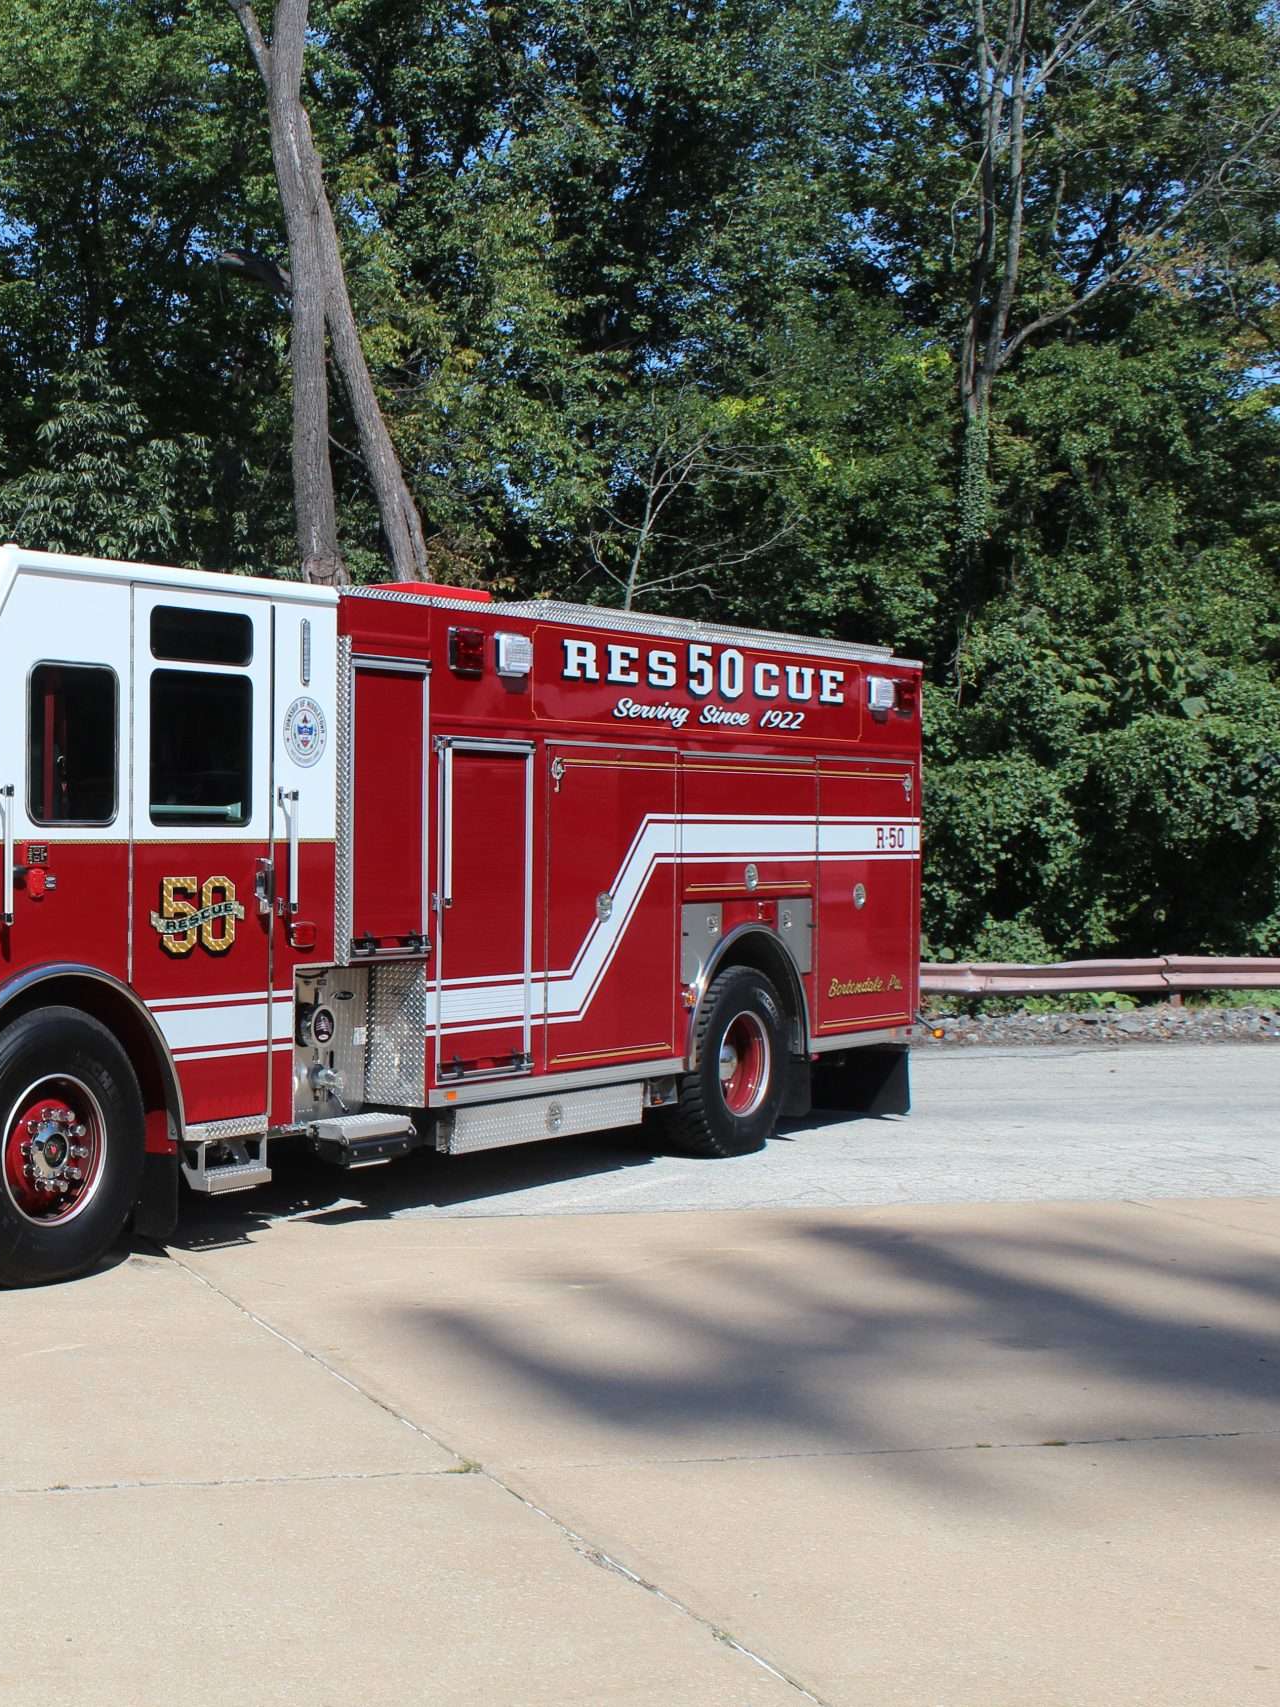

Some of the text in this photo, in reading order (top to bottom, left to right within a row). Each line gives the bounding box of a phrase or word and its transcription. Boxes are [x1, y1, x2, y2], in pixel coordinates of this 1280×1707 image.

[613, 697, 806, 730] Serving Since 1922
[162, 875, 236, 953] 50
[166, 902, 234, 931] RESCUE
